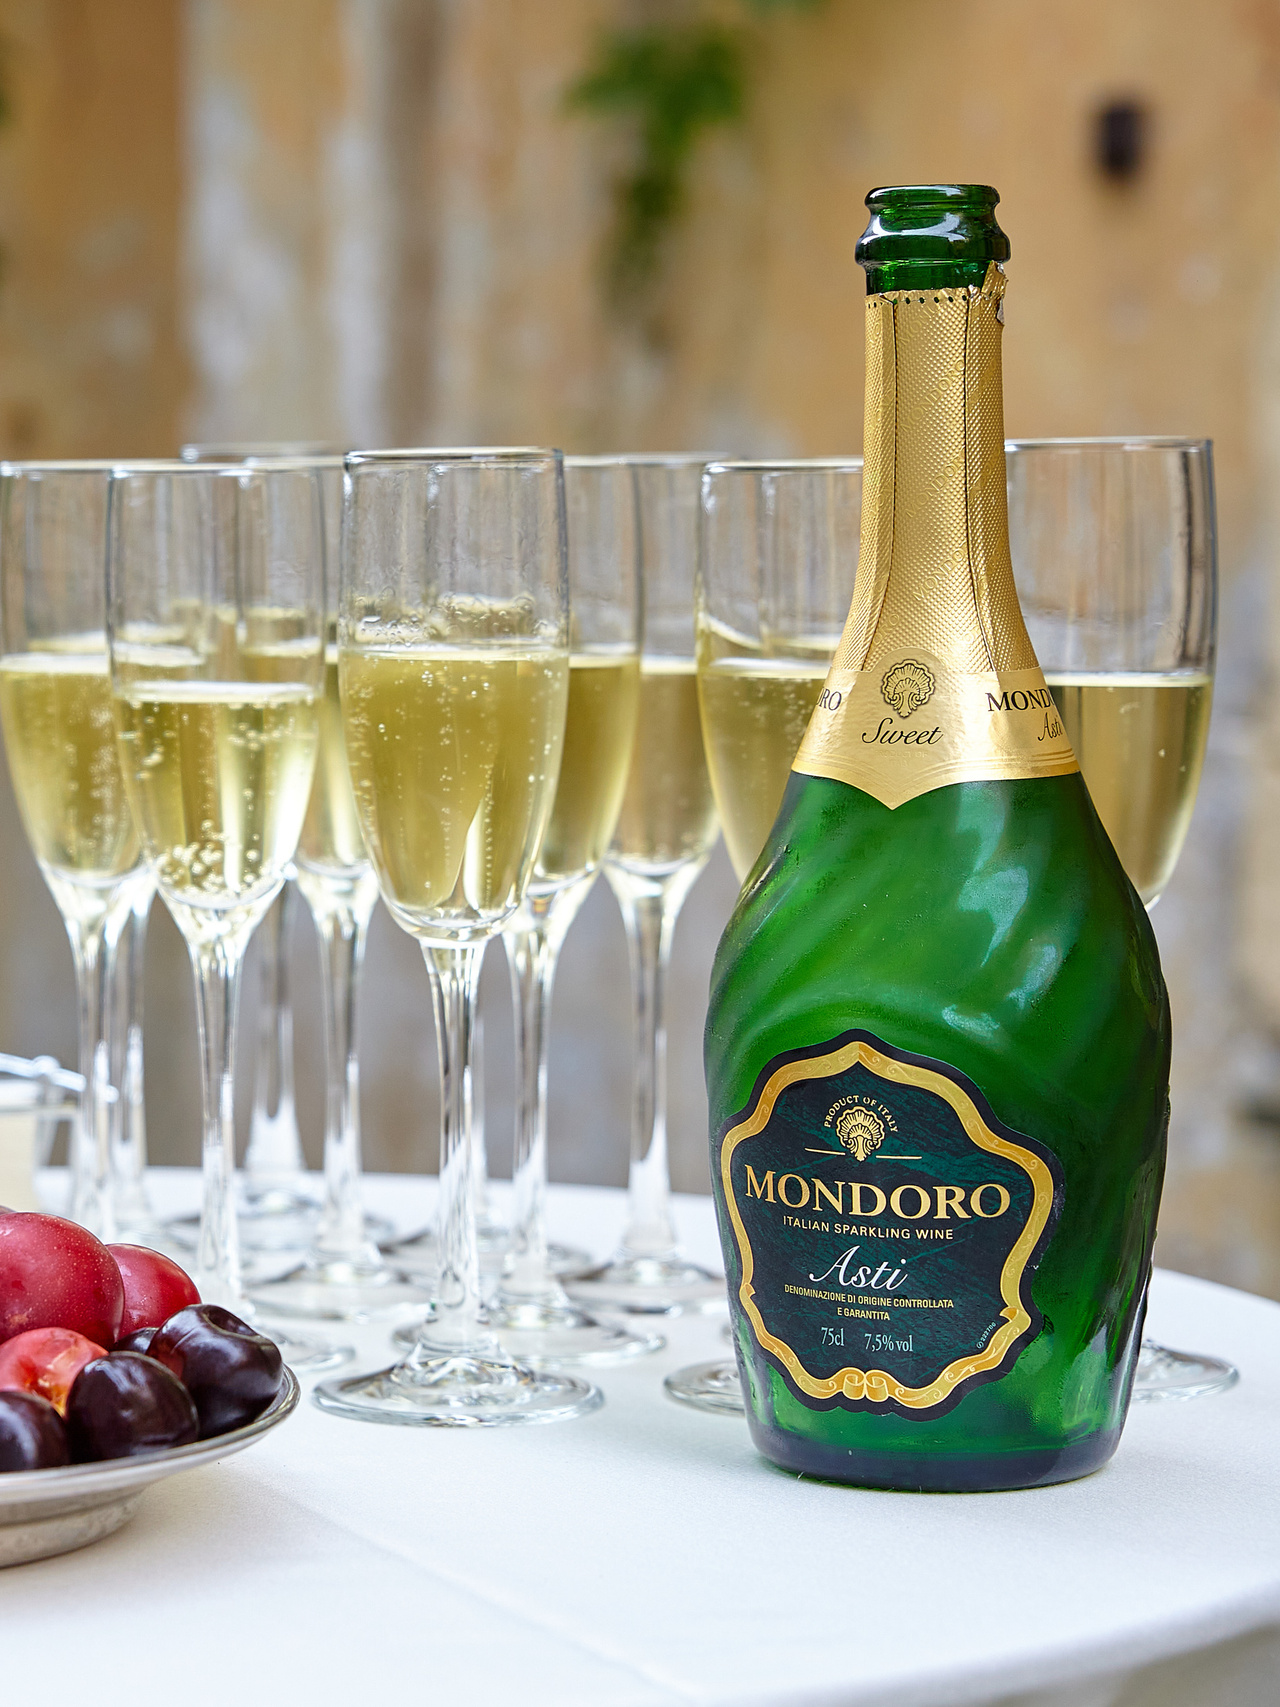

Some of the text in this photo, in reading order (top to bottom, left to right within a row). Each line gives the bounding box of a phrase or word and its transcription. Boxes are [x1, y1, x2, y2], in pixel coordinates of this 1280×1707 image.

[817, 688, 842, 711] RO
[862, 717, 944, 745] Sweet
[824, 1095, 898, 1132] PRODUCT OF ITALY
[745, 1164, 1011, 1220] MONDORO
[783, 1215, 954, 1240] ITALIAN SPARKLING WINE
[809, 1245, 909, 1291] Asti
[784, 1284, 954, 1309] DENOMINAZIONE DI ORIGINE CONTROLLATA
[837, 1307, 891, 1321] E GARANTITA
[821, 1327, 914, 1352] 75cl 7,5% vol
